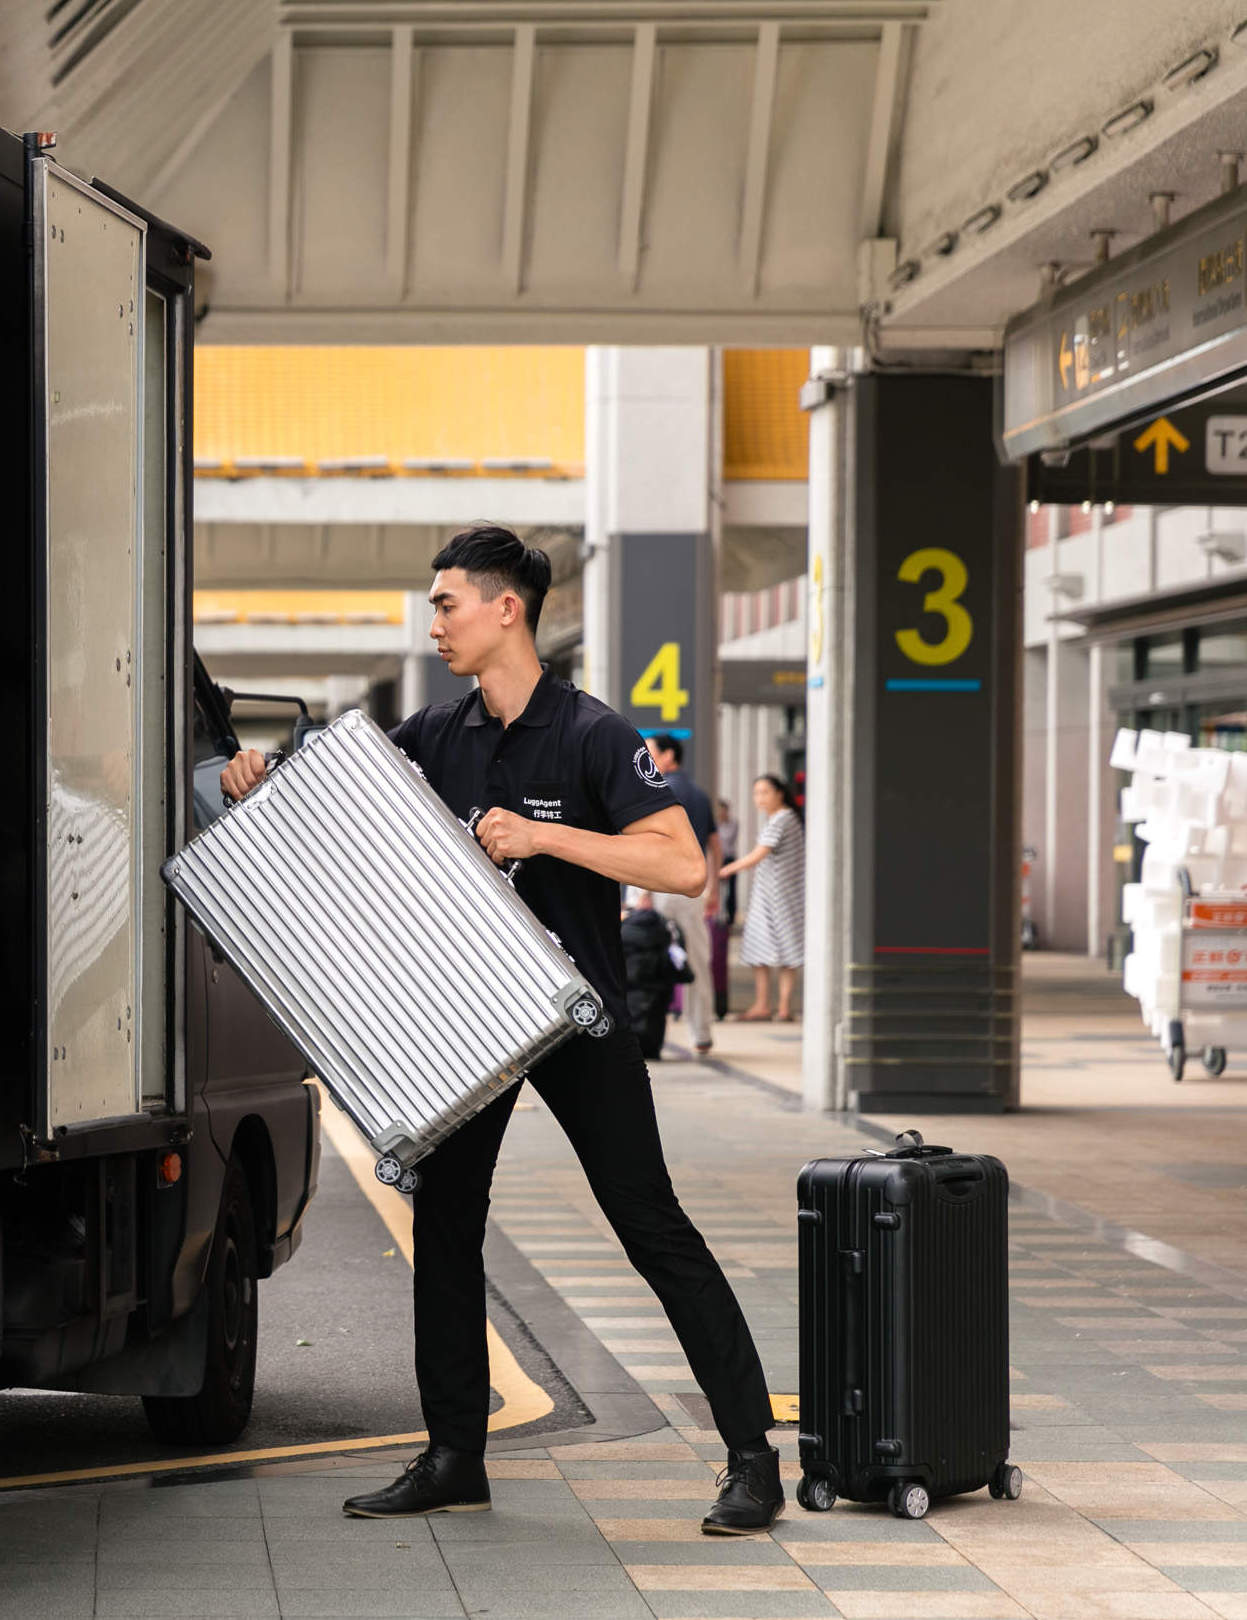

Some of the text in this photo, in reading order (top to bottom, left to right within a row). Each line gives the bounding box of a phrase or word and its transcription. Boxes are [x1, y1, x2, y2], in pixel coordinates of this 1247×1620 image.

[894, 547, 974, 666] 3
[630, 642, 689, 721] 4
[523, 796, 561, 808] LuggAgent
